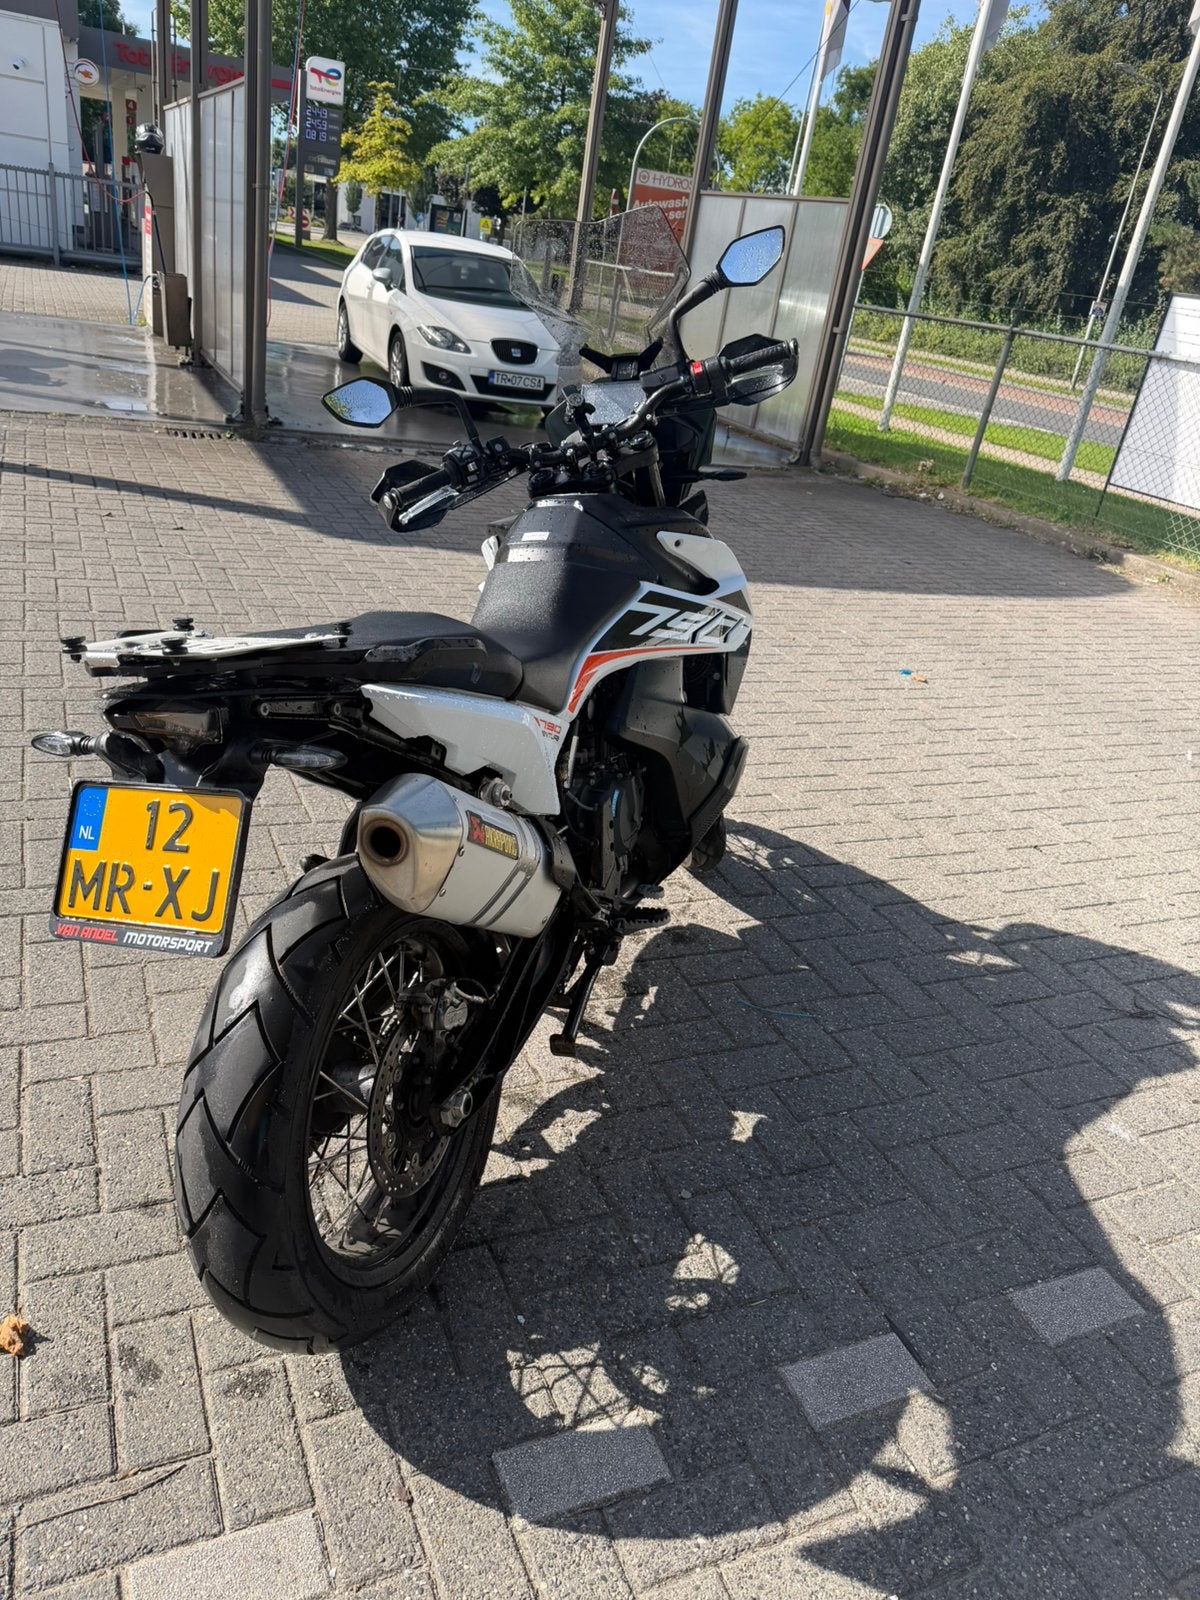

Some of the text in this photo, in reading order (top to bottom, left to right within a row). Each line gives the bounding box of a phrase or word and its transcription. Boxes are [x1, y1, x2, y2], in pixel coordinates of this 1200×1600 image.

[78, 825, 95, 840] NL
[146, 799, 194, 853] 12
[56, 924, 213, 953] VAN ANDEL MOTORSPORT
